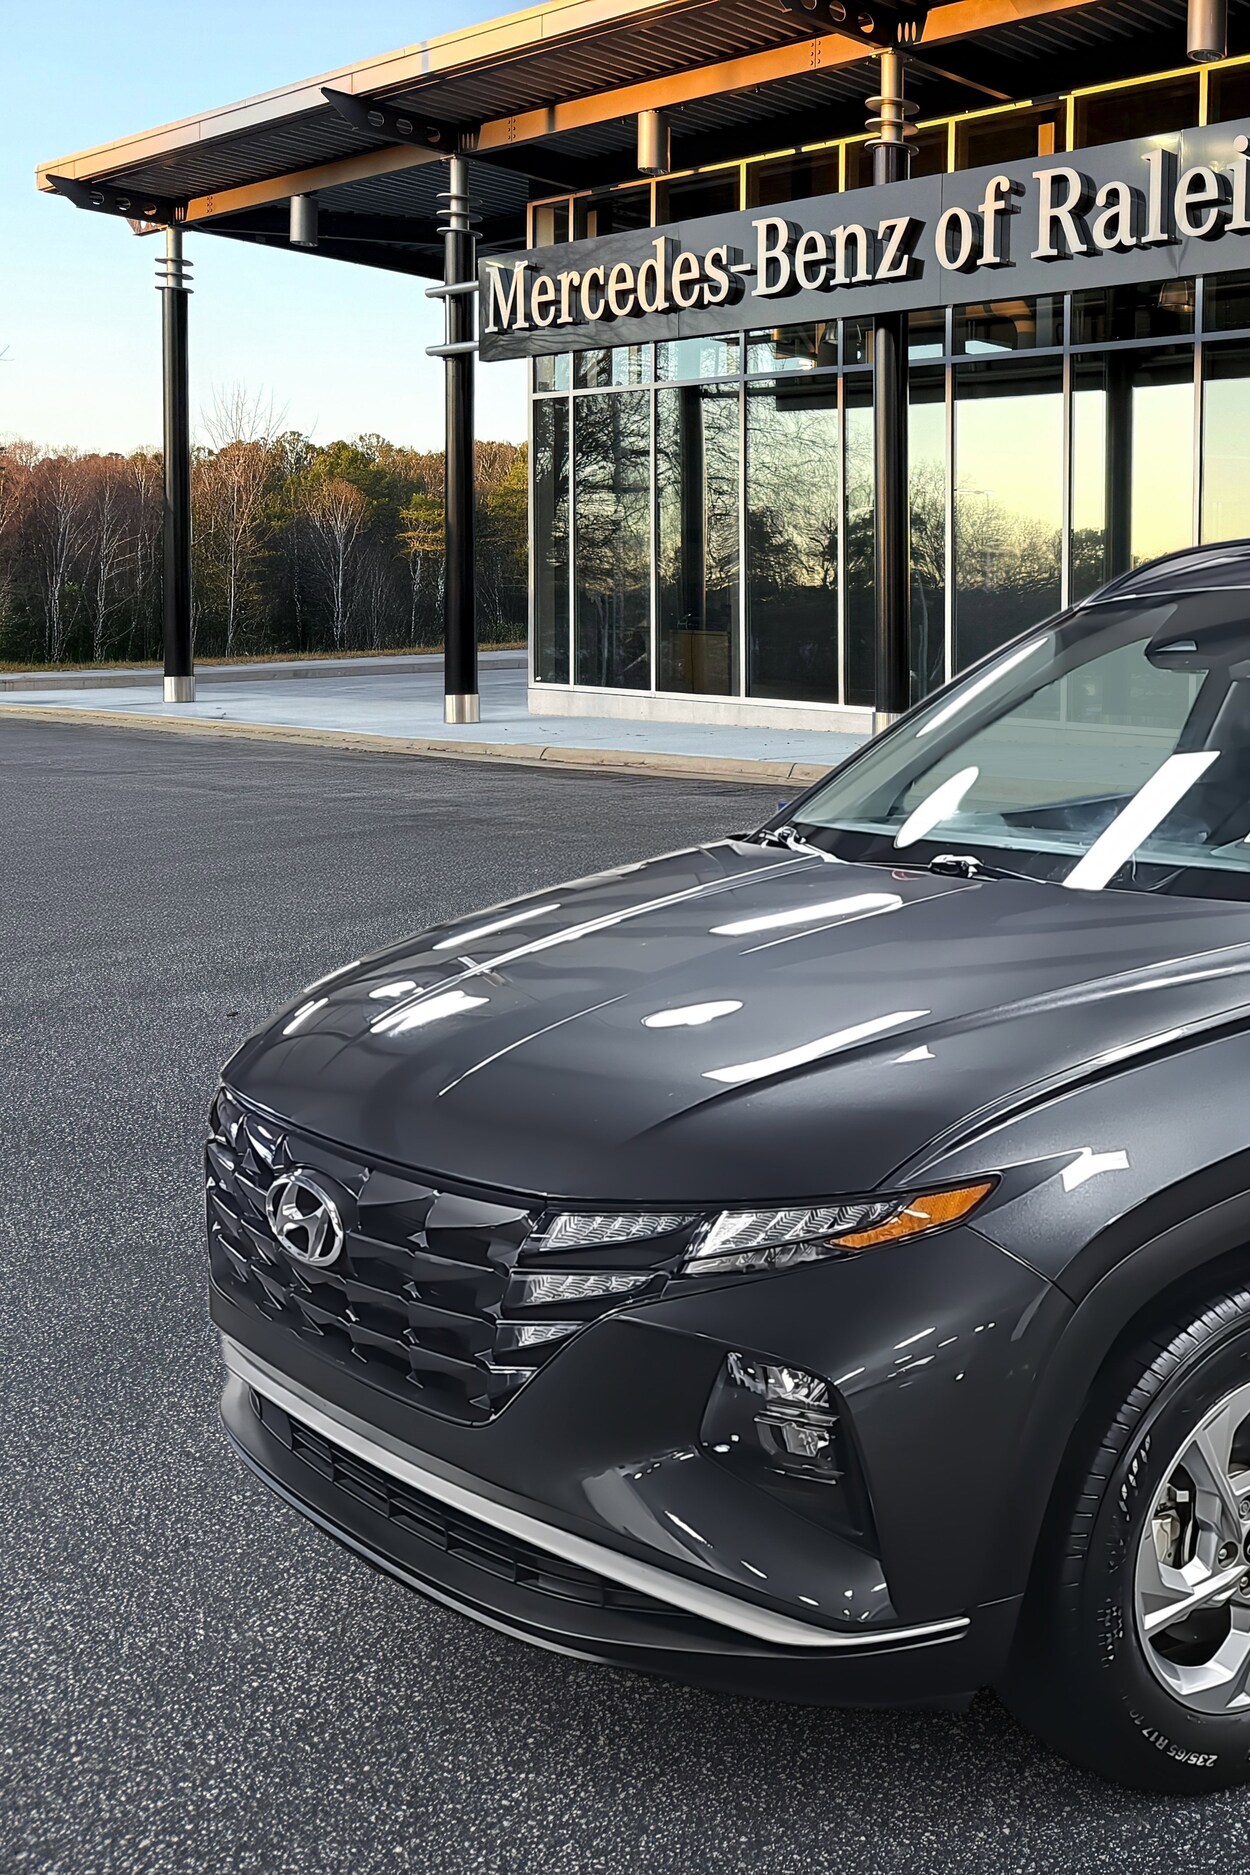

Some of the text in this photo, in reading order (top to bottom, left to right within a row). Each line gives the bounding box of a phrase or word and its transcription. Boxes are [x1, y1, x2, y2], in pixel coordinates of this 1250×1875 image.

[484, 216, 911, 334] Mercedes-Benz
[935, 175, 1012, 272] of
[1142, 1727, 1218, 1767] 235/65 R17
